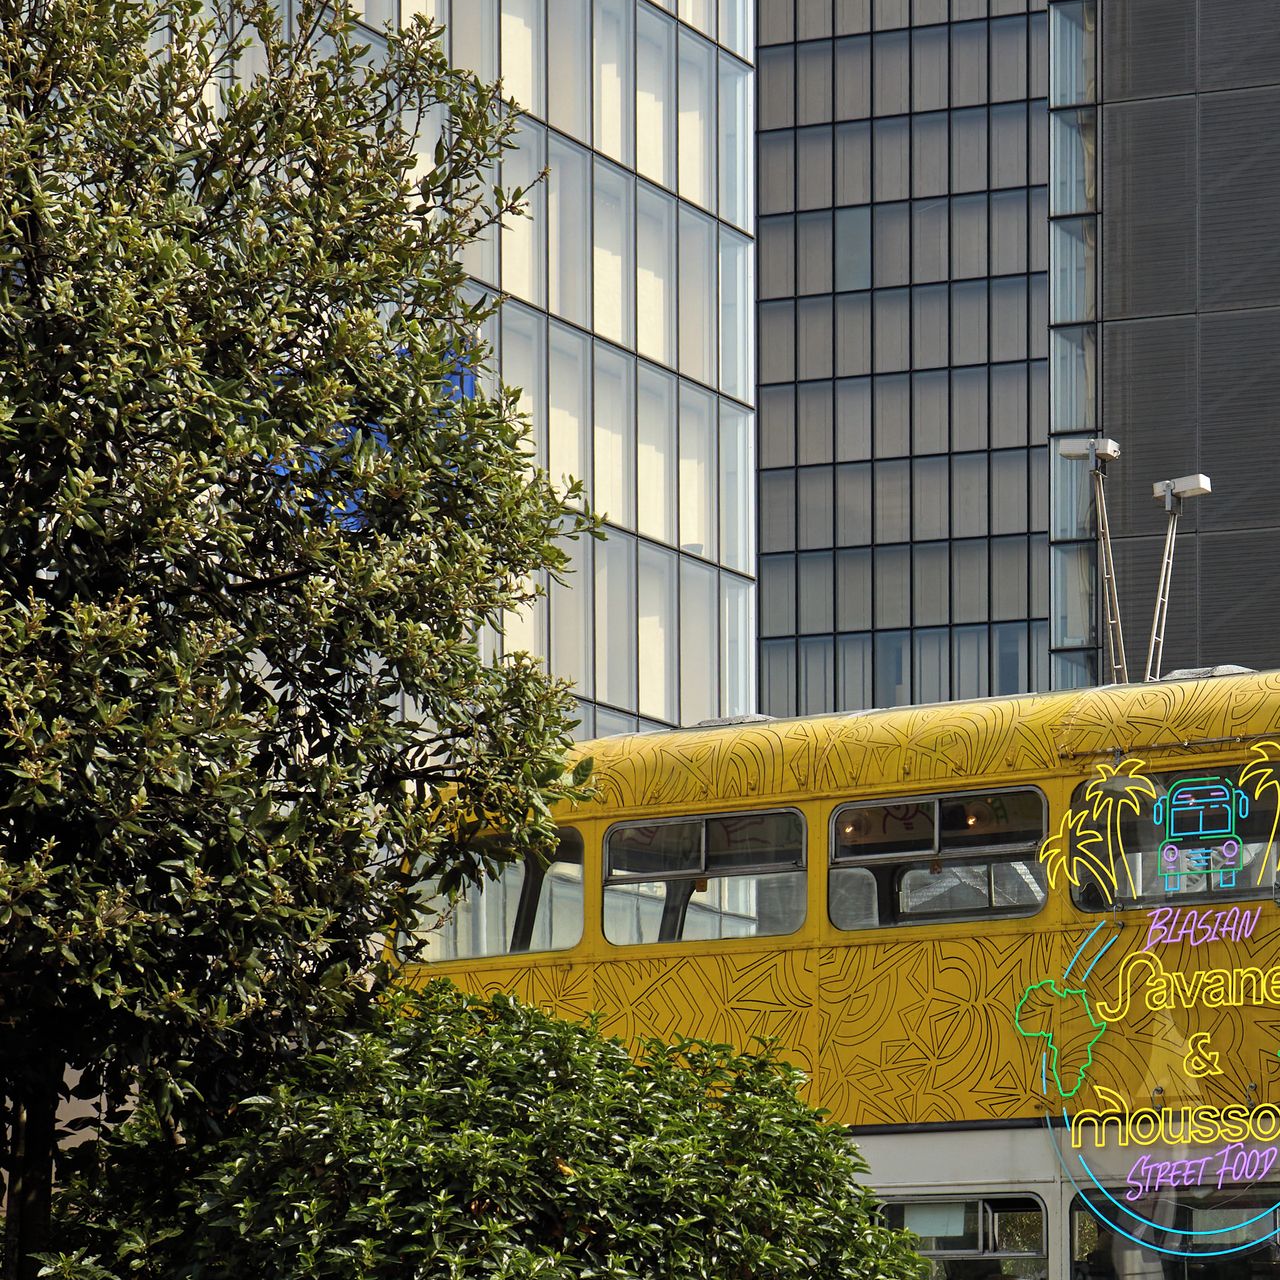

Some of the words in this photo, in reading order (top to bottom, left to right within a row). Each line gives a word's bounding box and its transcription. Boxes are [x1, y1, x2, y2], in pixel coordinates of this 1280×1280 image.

[1141, 906, 1262, 953] BLASIAN
[1183, 1032, 1225, 1078] &
[1126, 1154, 1213, 1202] STREET
[1213, 1142, 1278, 1190] FOOD
